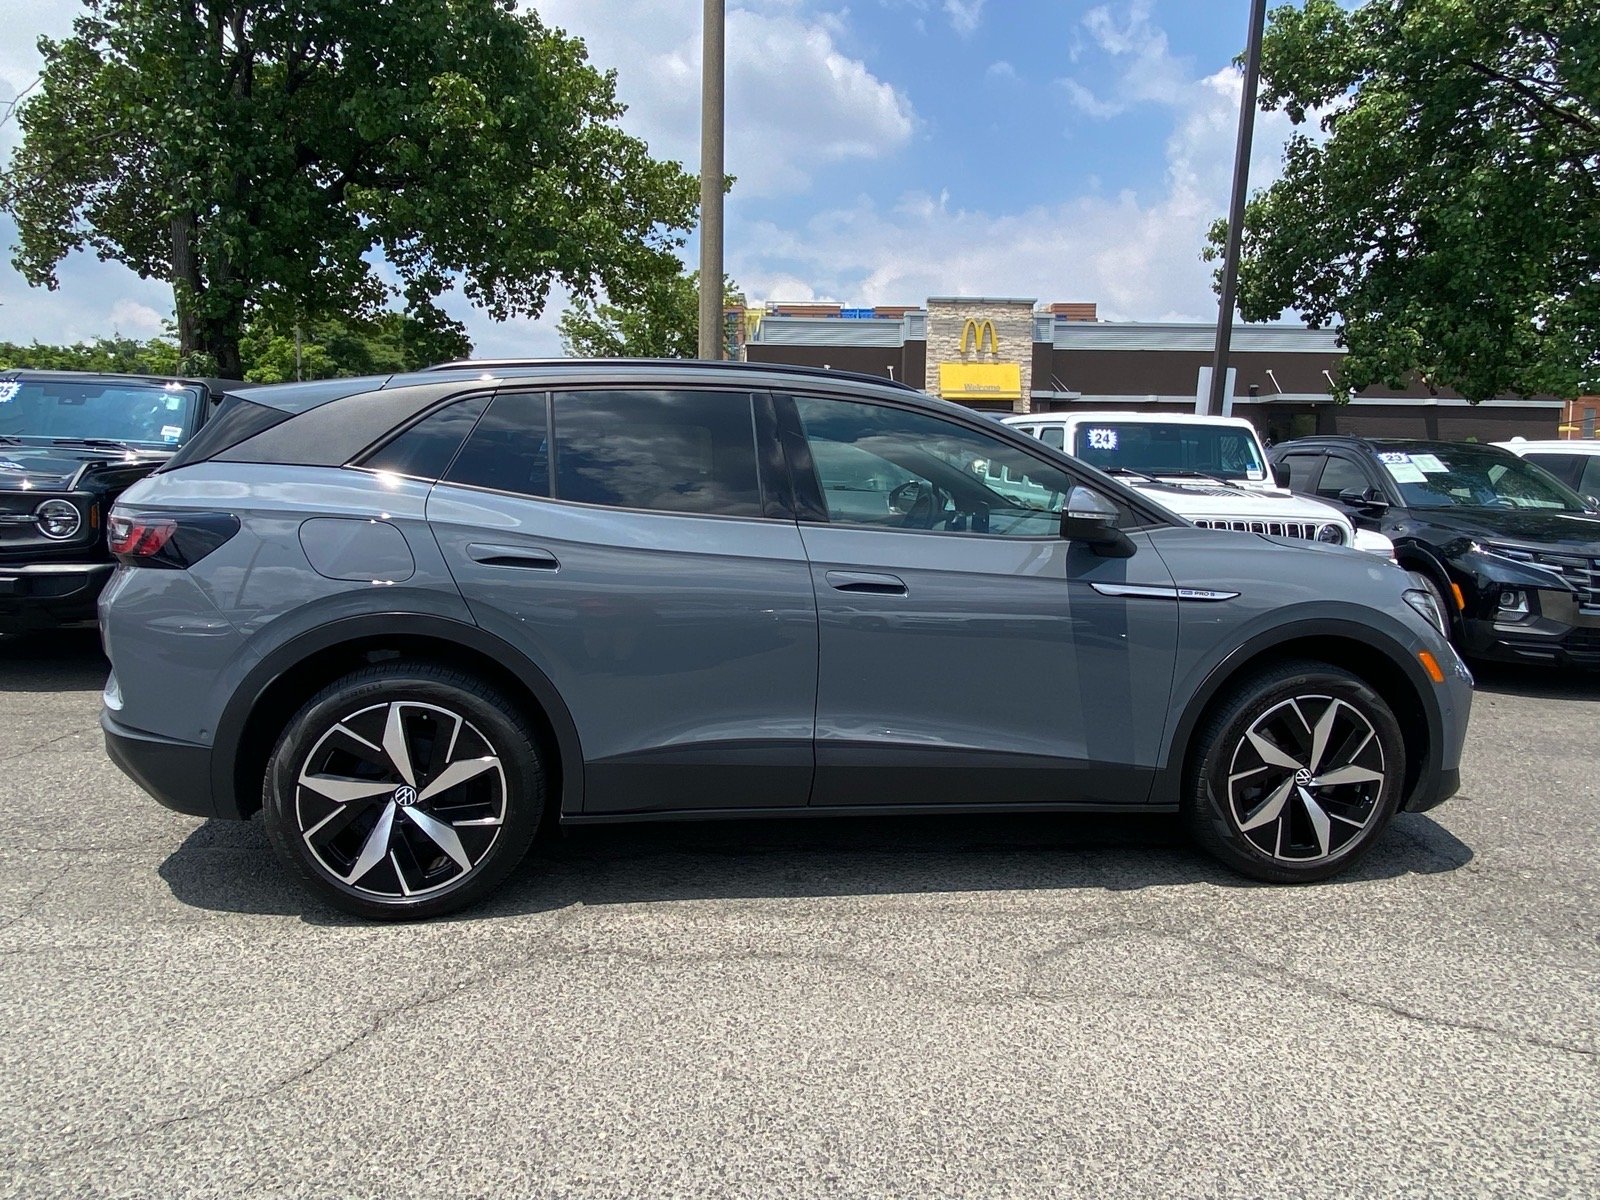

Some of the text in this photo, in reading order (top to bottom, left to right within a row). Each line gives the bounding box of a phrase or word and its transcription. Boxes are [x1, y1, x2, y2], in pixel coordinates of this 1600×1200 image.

[964, 384, 1001, 392] Welcome
[1094, 432, 1110, 445] 24
[1385, 454, 1403, 462] 23
